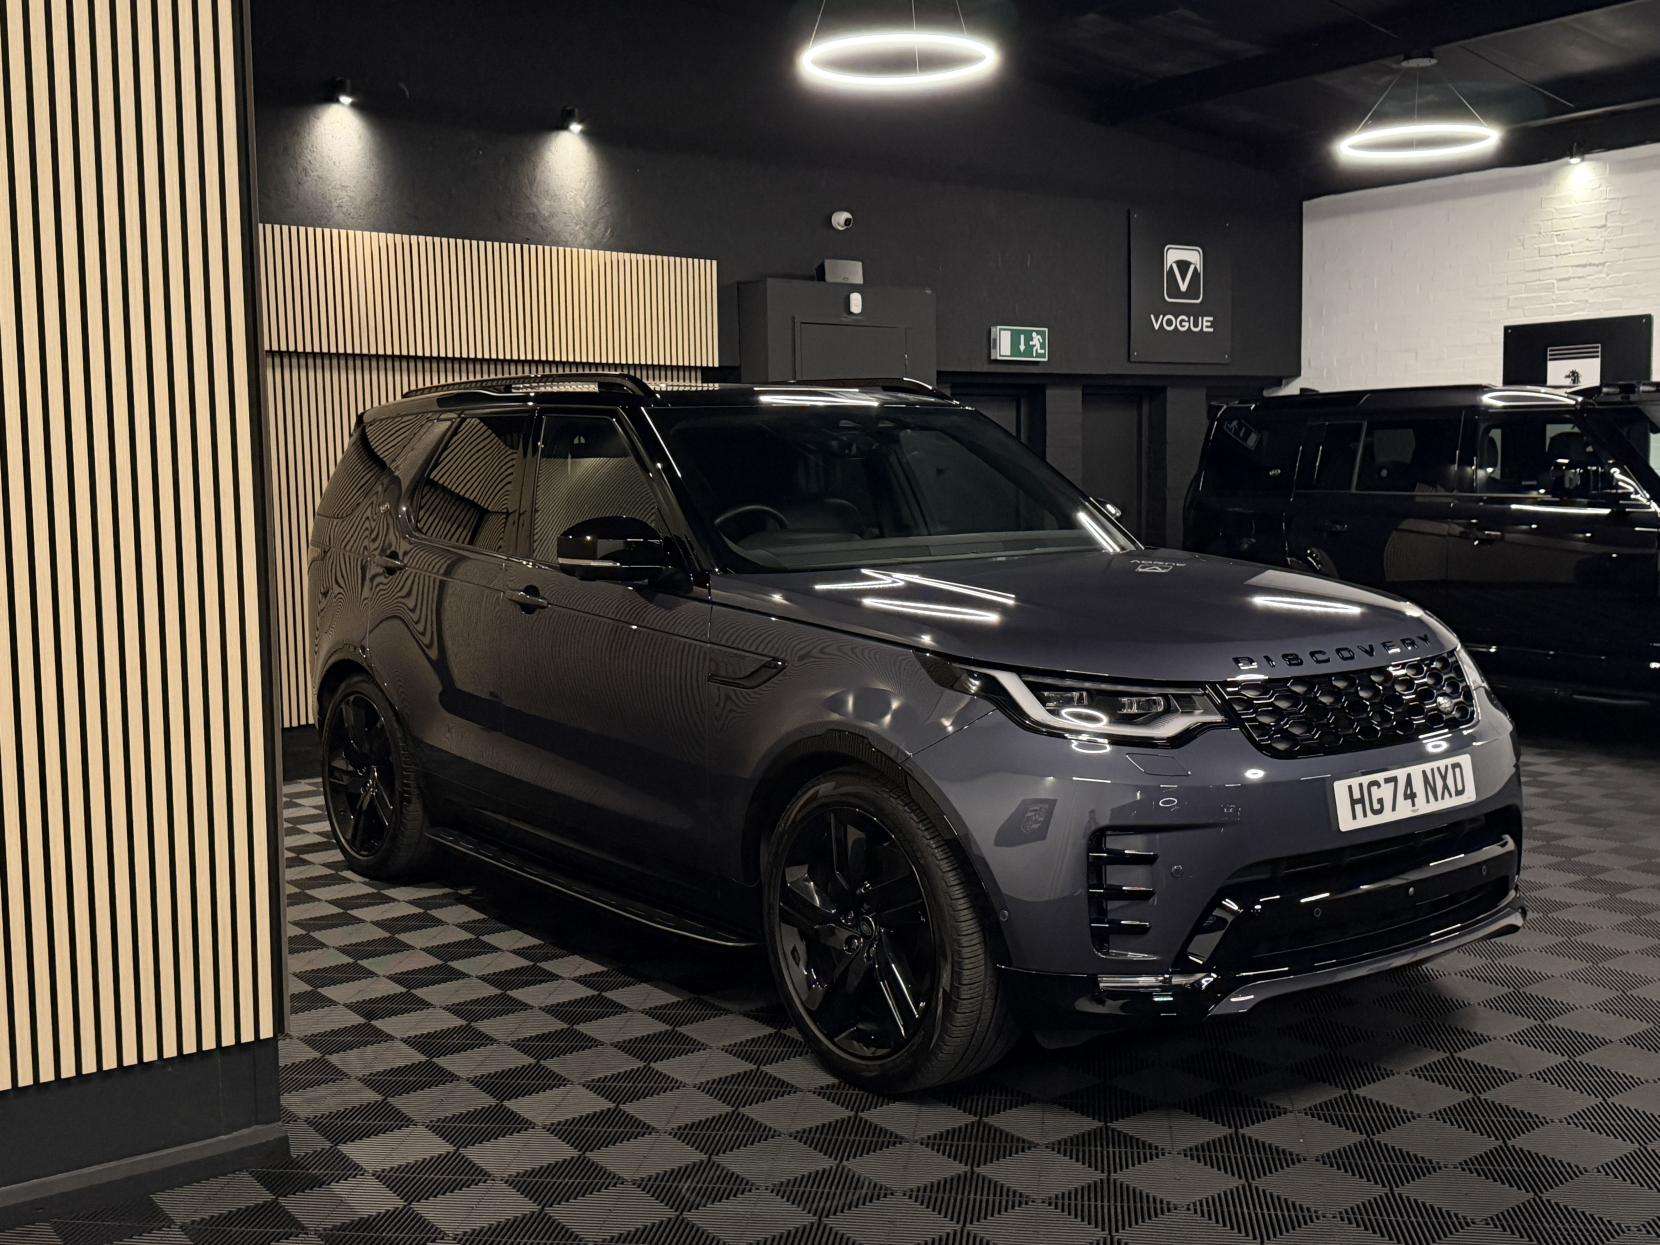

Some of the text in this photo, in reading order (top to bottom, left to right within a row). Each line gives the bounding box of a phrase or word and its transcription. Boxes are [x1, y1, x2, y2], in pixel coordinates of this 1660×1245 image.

[1150, 314, 1214, 332] VOGUE
[1232, 634, 1432, 670] DISCOVERY
[1347, 762, 1466, 820] HG74 NXD
